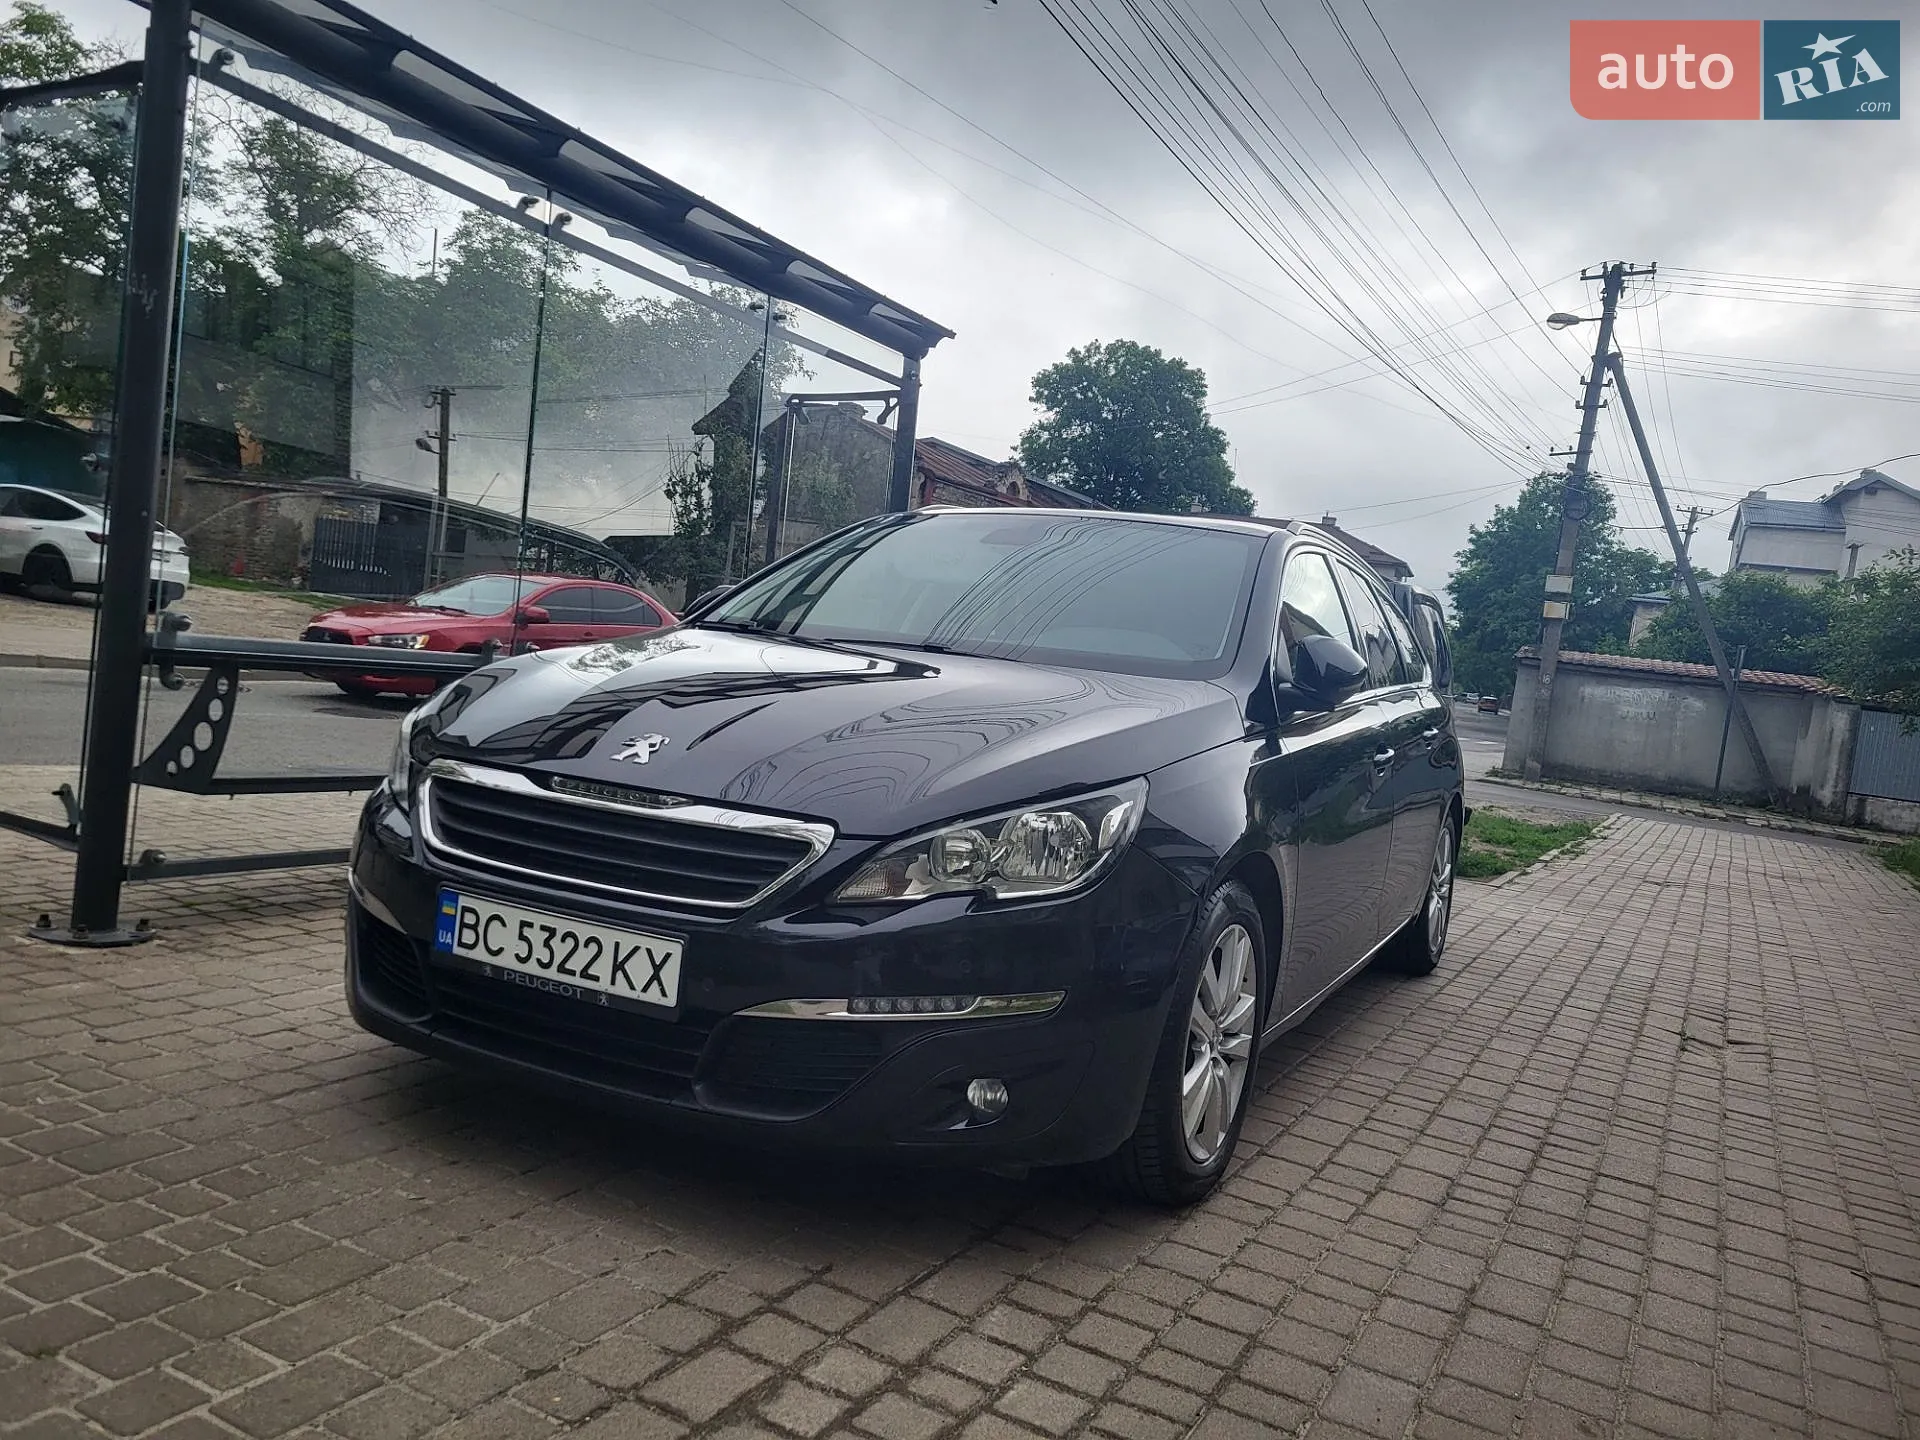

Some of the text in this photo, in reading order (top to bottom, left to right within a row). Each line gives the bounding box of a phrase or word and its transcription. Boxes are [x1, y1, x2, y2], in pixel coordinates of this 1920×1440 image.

[438, 929, 453, 945] UA
[457, 905, 673, 998] BC 5322 KX
[503, 970, 584, 1000] PEUGEOT
